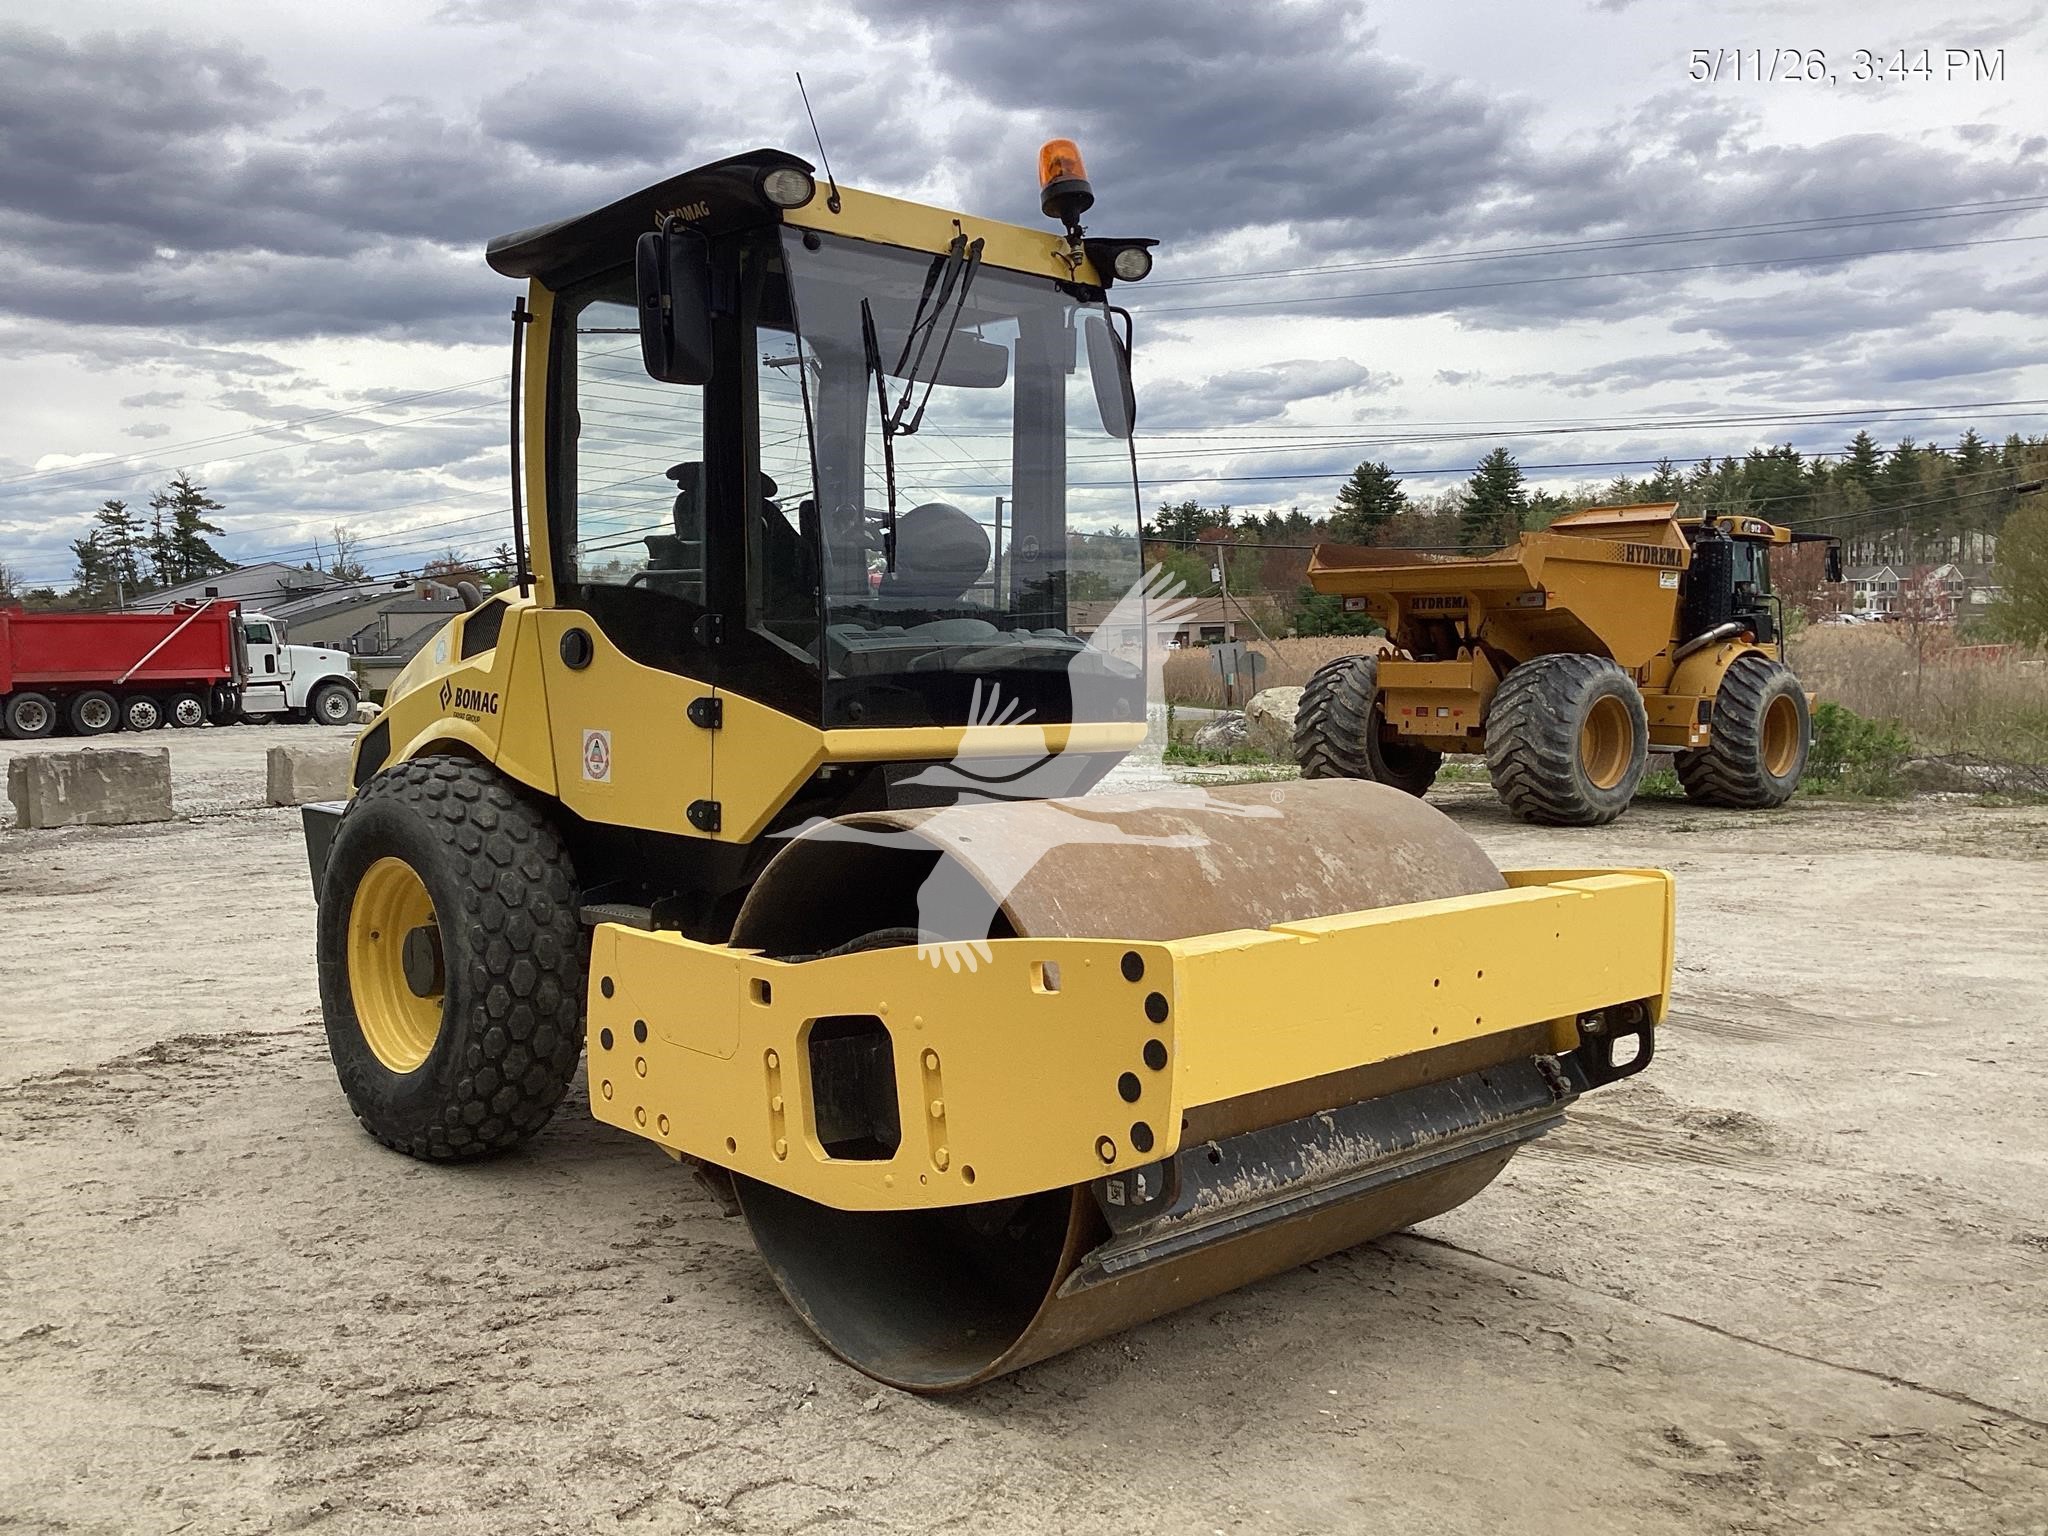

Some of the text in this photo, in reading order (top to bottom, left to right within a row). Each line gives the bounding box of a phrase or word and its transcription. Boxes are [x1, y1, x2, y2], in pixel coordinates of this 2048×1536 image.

[1626, 543, 1683, 567] HYDREMA
[1411, 596, 1470, 609] HYDREMA
[454, 687, 498, 714] BOMAG
